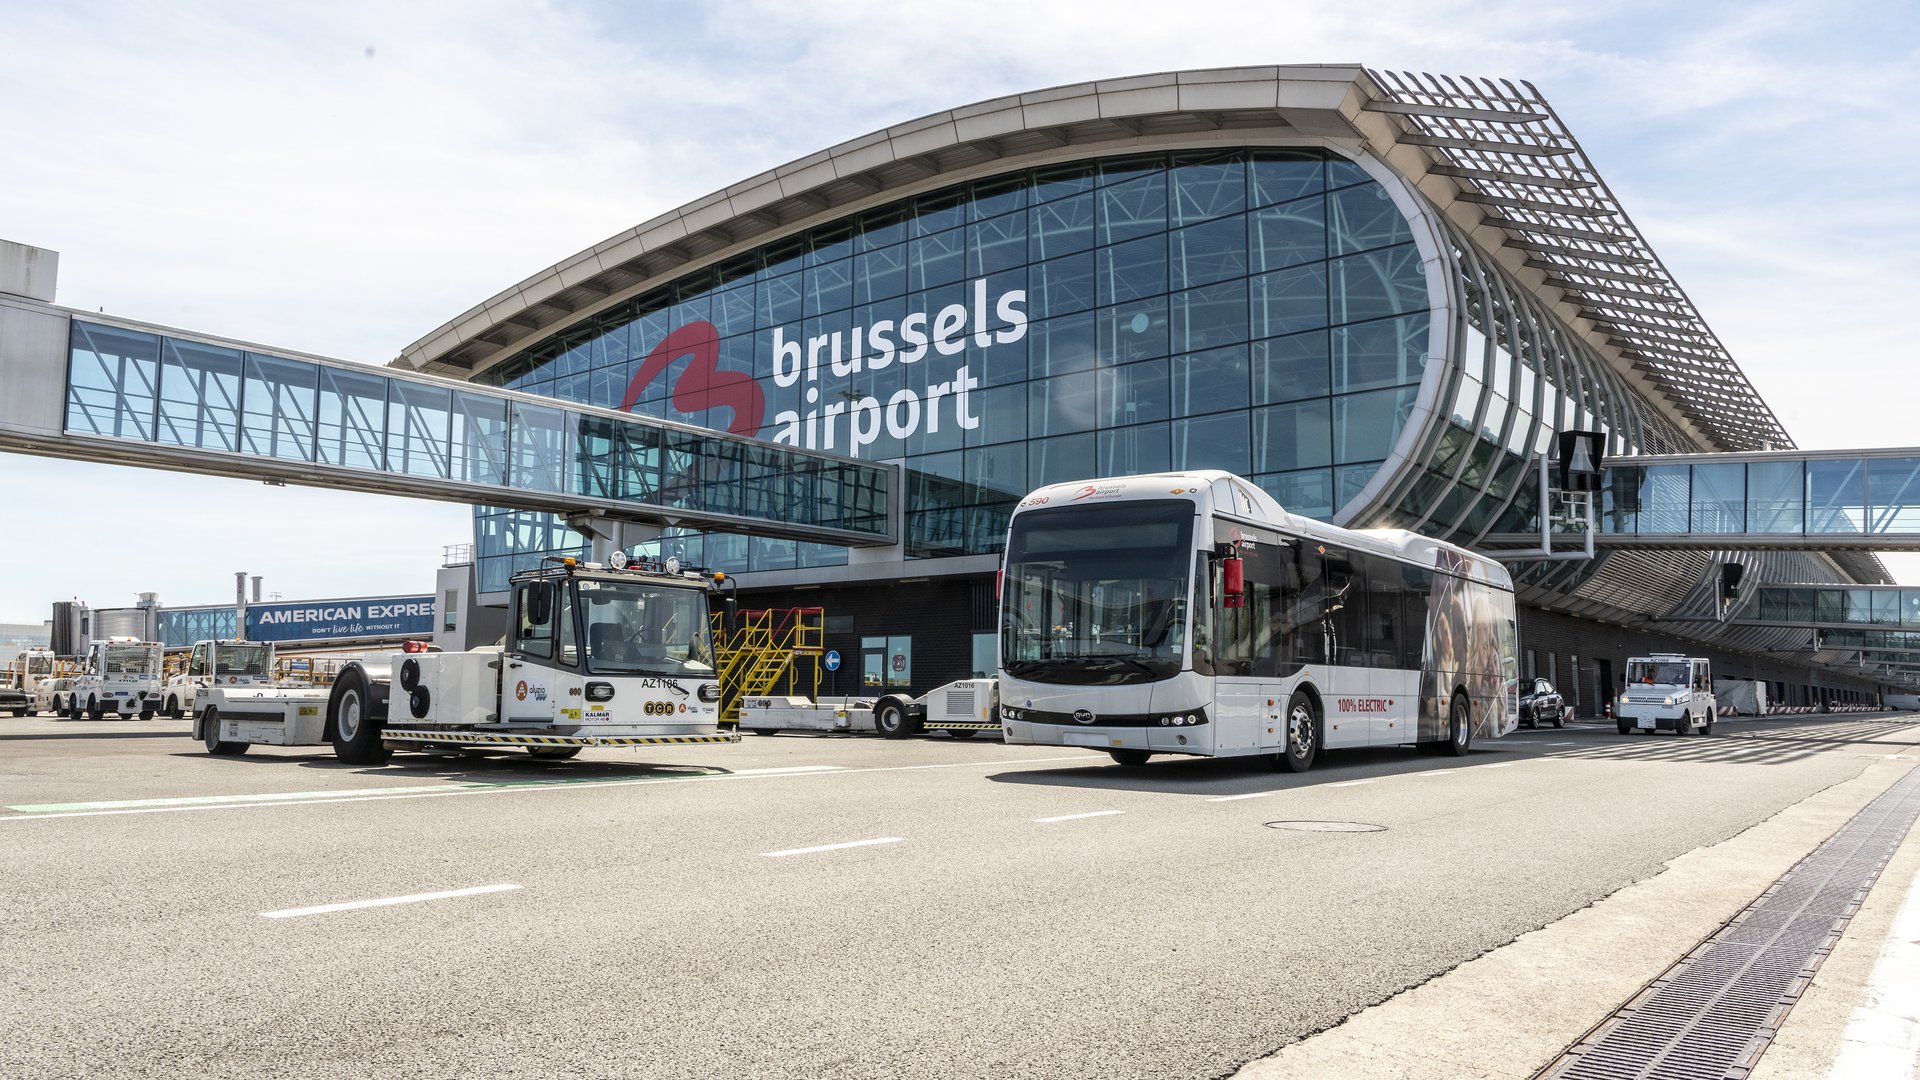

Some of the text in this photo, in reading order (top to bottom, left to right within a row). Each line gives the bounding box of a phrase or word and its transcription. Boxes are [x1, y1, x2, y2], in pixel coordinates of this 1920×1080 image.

[772, 278, 1028, 388] brussels
[772, 365, 980, 458] airport
[1028, 497, 1049, 506] 590
[1240, 531, 1257, 542] brussels
[1241, 540, 1256, 550] airport
[259, 606, 361, 625] AMERICAN
[333, 624, 349, 634] live
[350, 623, 364, 634] life
[641, 678, 678, 689] AZ1106
[645, 703, 674, 714] TCR
[1338, 699, 1387, 712] 100% ELECTRIC
